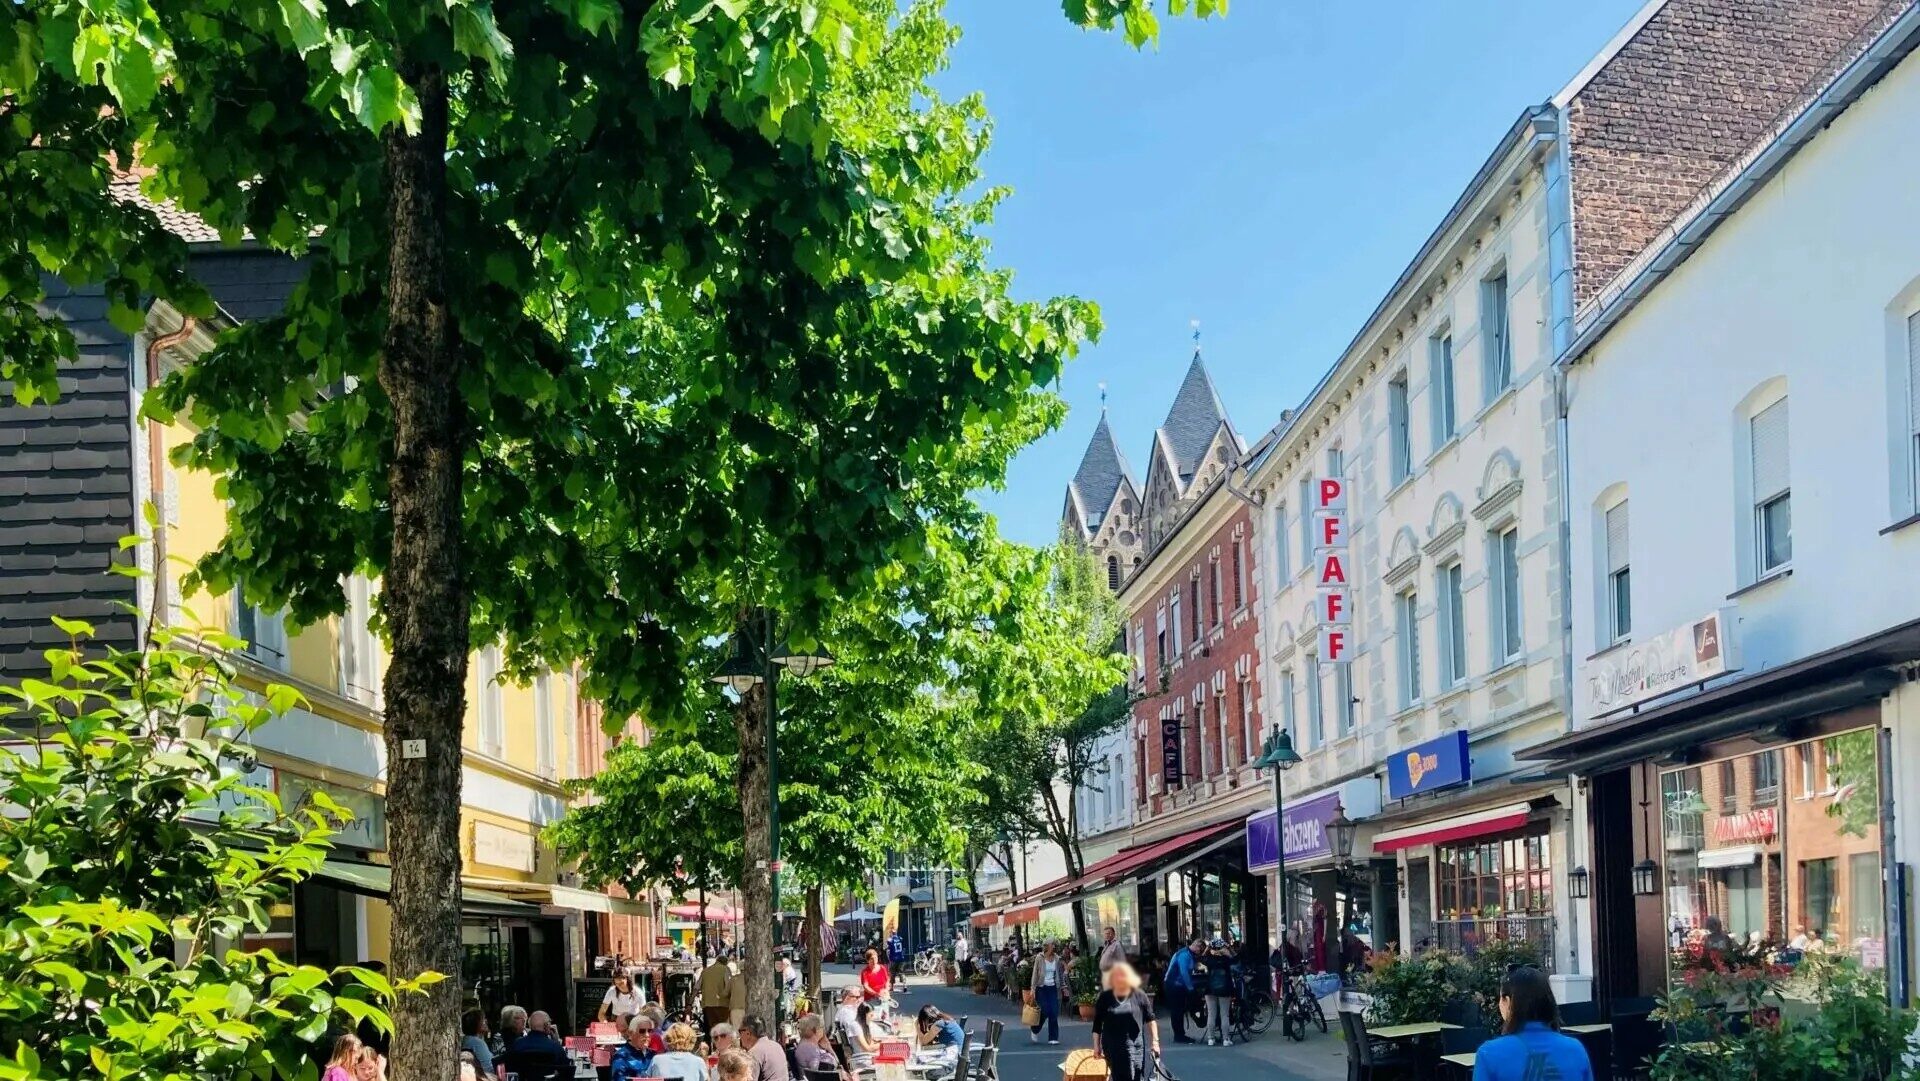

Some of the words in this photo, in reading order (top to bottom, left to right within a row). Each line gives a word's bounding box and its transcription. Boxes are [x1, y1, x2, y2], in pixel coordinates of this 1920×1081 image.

[1320, 479, 1345, 660] PFAFF
[409, 743, 420, 754] 14
[1163, 723, 1178, 779] CAFE
[1275, 814, 1320, 856] ähszene
[893, 942, 903, 953] 13
